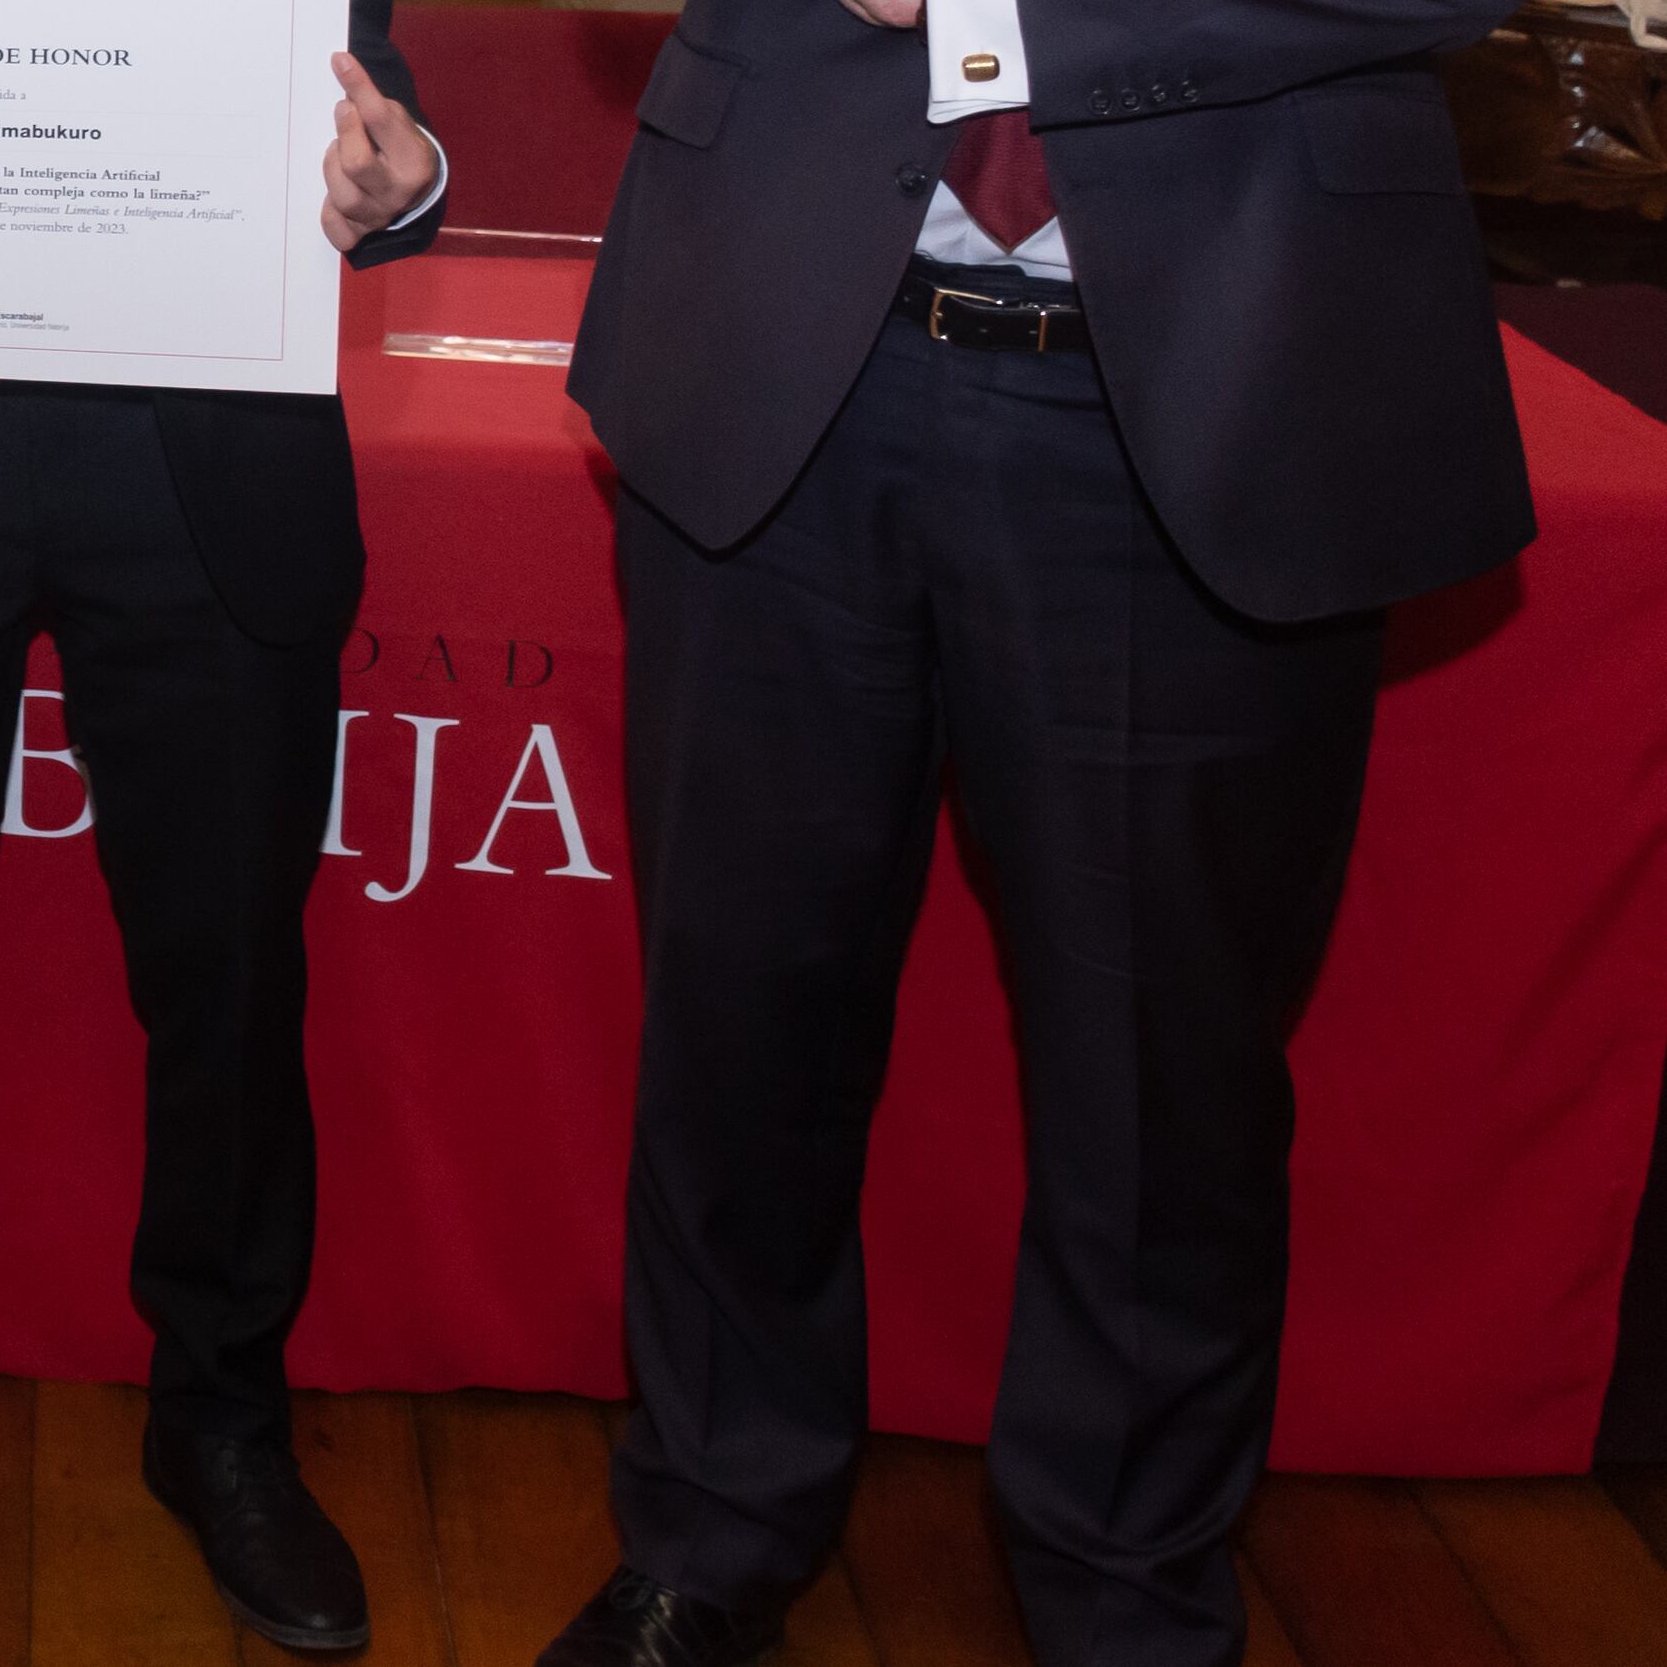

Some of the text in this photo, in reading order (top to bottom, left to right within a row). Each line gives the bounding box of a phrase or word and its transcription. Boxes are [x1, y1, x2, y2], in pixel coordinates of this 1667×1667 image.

[29, 48, 133, 67] HONOR
[20, 92, 26, 101] a
[3, 166, 15, 177] la
[20, 167, 98, 182] Inteligencia
[101, 168, 161, 182] Artificial
[24, 185, 84, 200] compleja
[90, 189, 129, 198] como
[133, 187, 145, 199] la
[64, 204, 110, 216] Limeñas
[113, 209, 120, 217] e
[123, 205, 184, 221] Inteligencia
[10, 220, 73, 233] noviembre
[77, 222, 92, 233] de
